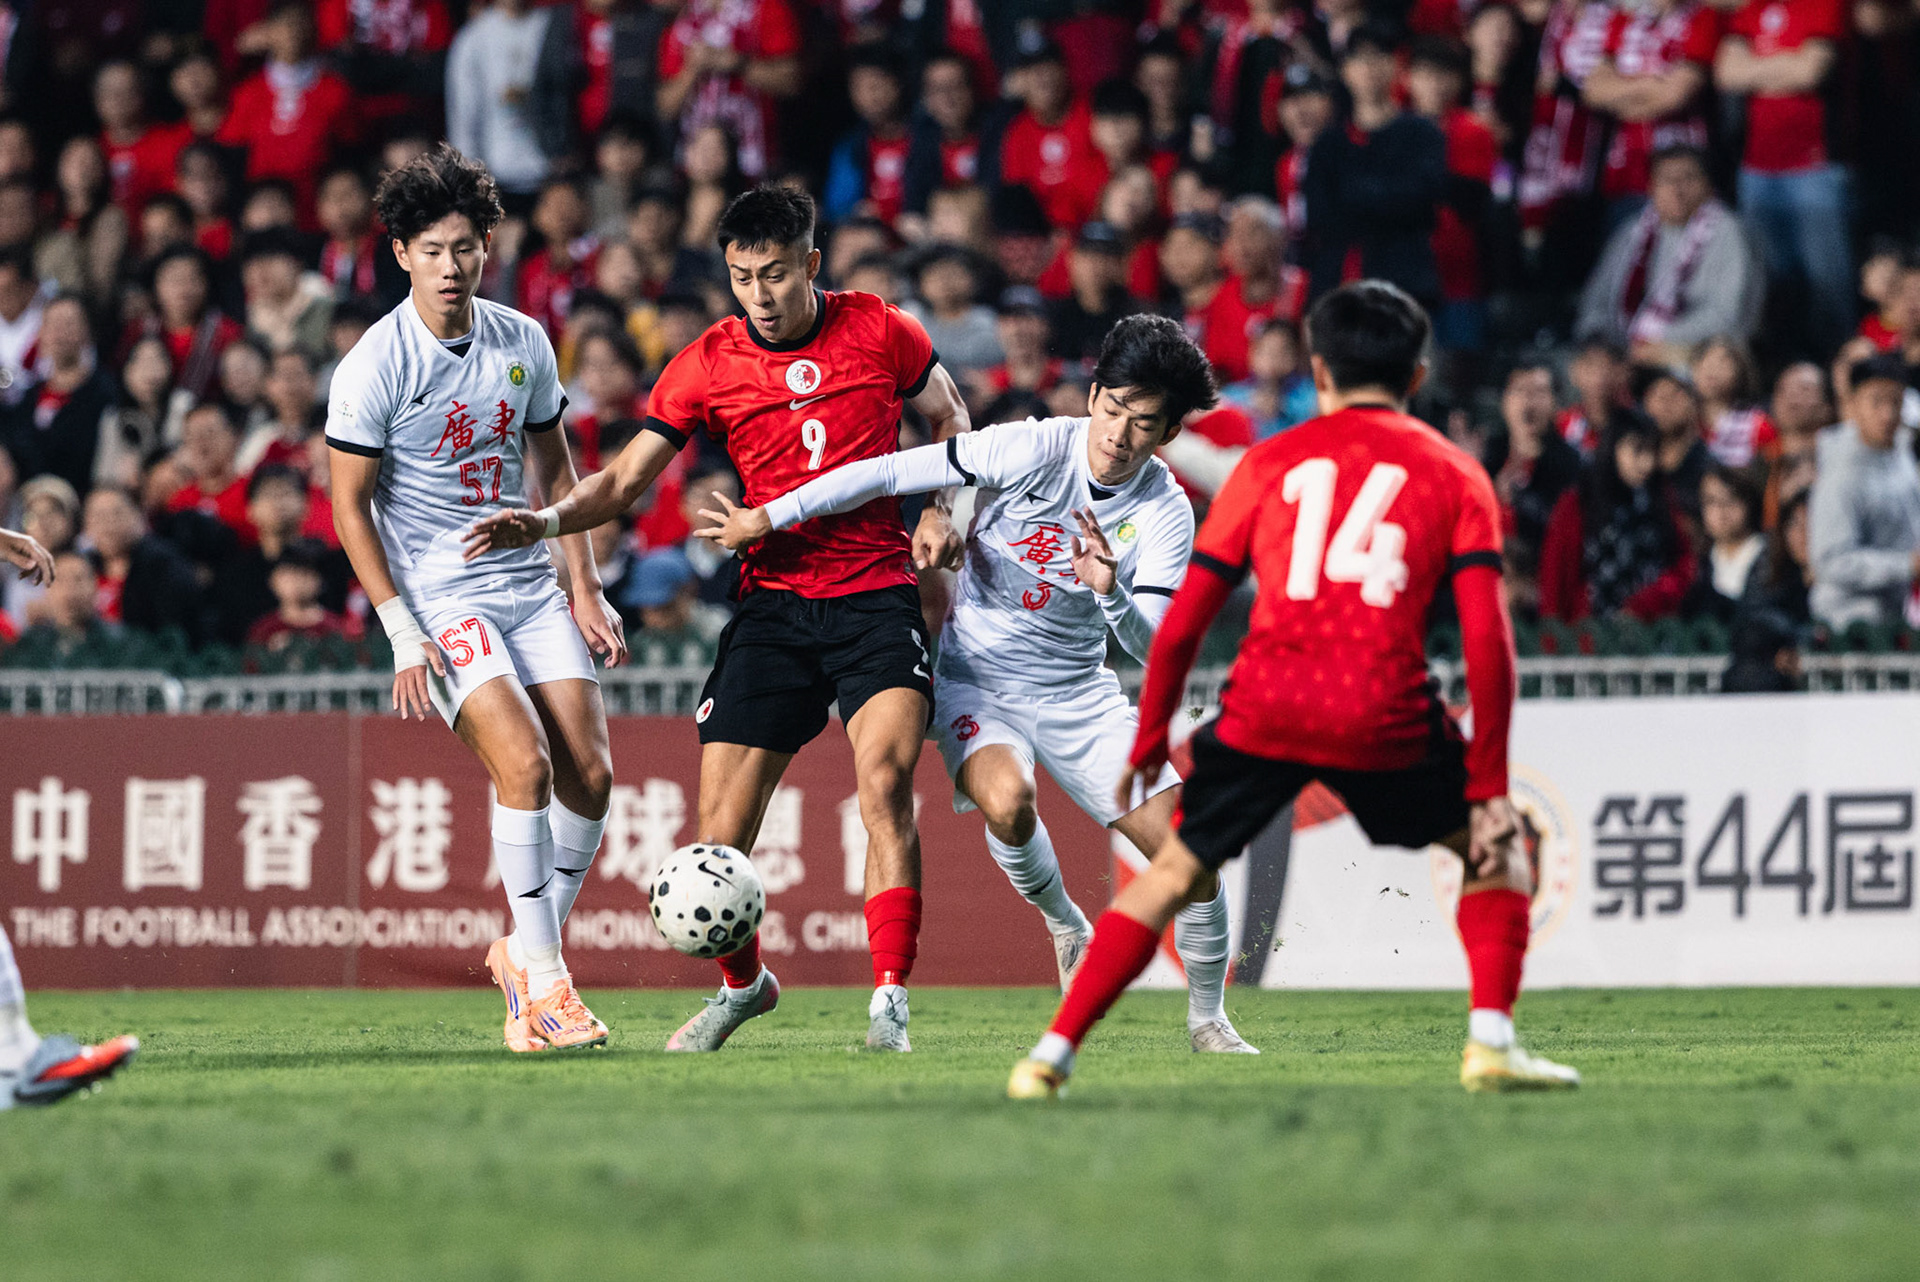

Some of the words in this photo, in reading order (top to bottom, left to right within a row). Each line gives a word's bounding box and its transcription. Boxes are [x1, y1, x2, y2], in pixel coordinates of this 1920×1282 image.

[430, 399, 516, 458] 廣東
[800, 418, 827, 471] 9
[459, 455, 503, 506] 57
[1006, 523, 1081, 585] 廣
[1281, 457, 1409, 609] 14
[438, 617, 492, 668] 57
[951, 714, 981, 742] 3
[1593, 790, 1914, 920] 第44屆
[10, 906, 78, 948] THE
[83, 906, 257, 949] FOOTBALL
[261, 906, 506, 949] ASSOCIATION
[568, 908, 670, 951] HON
[802, 910, 870, 952] CHI
